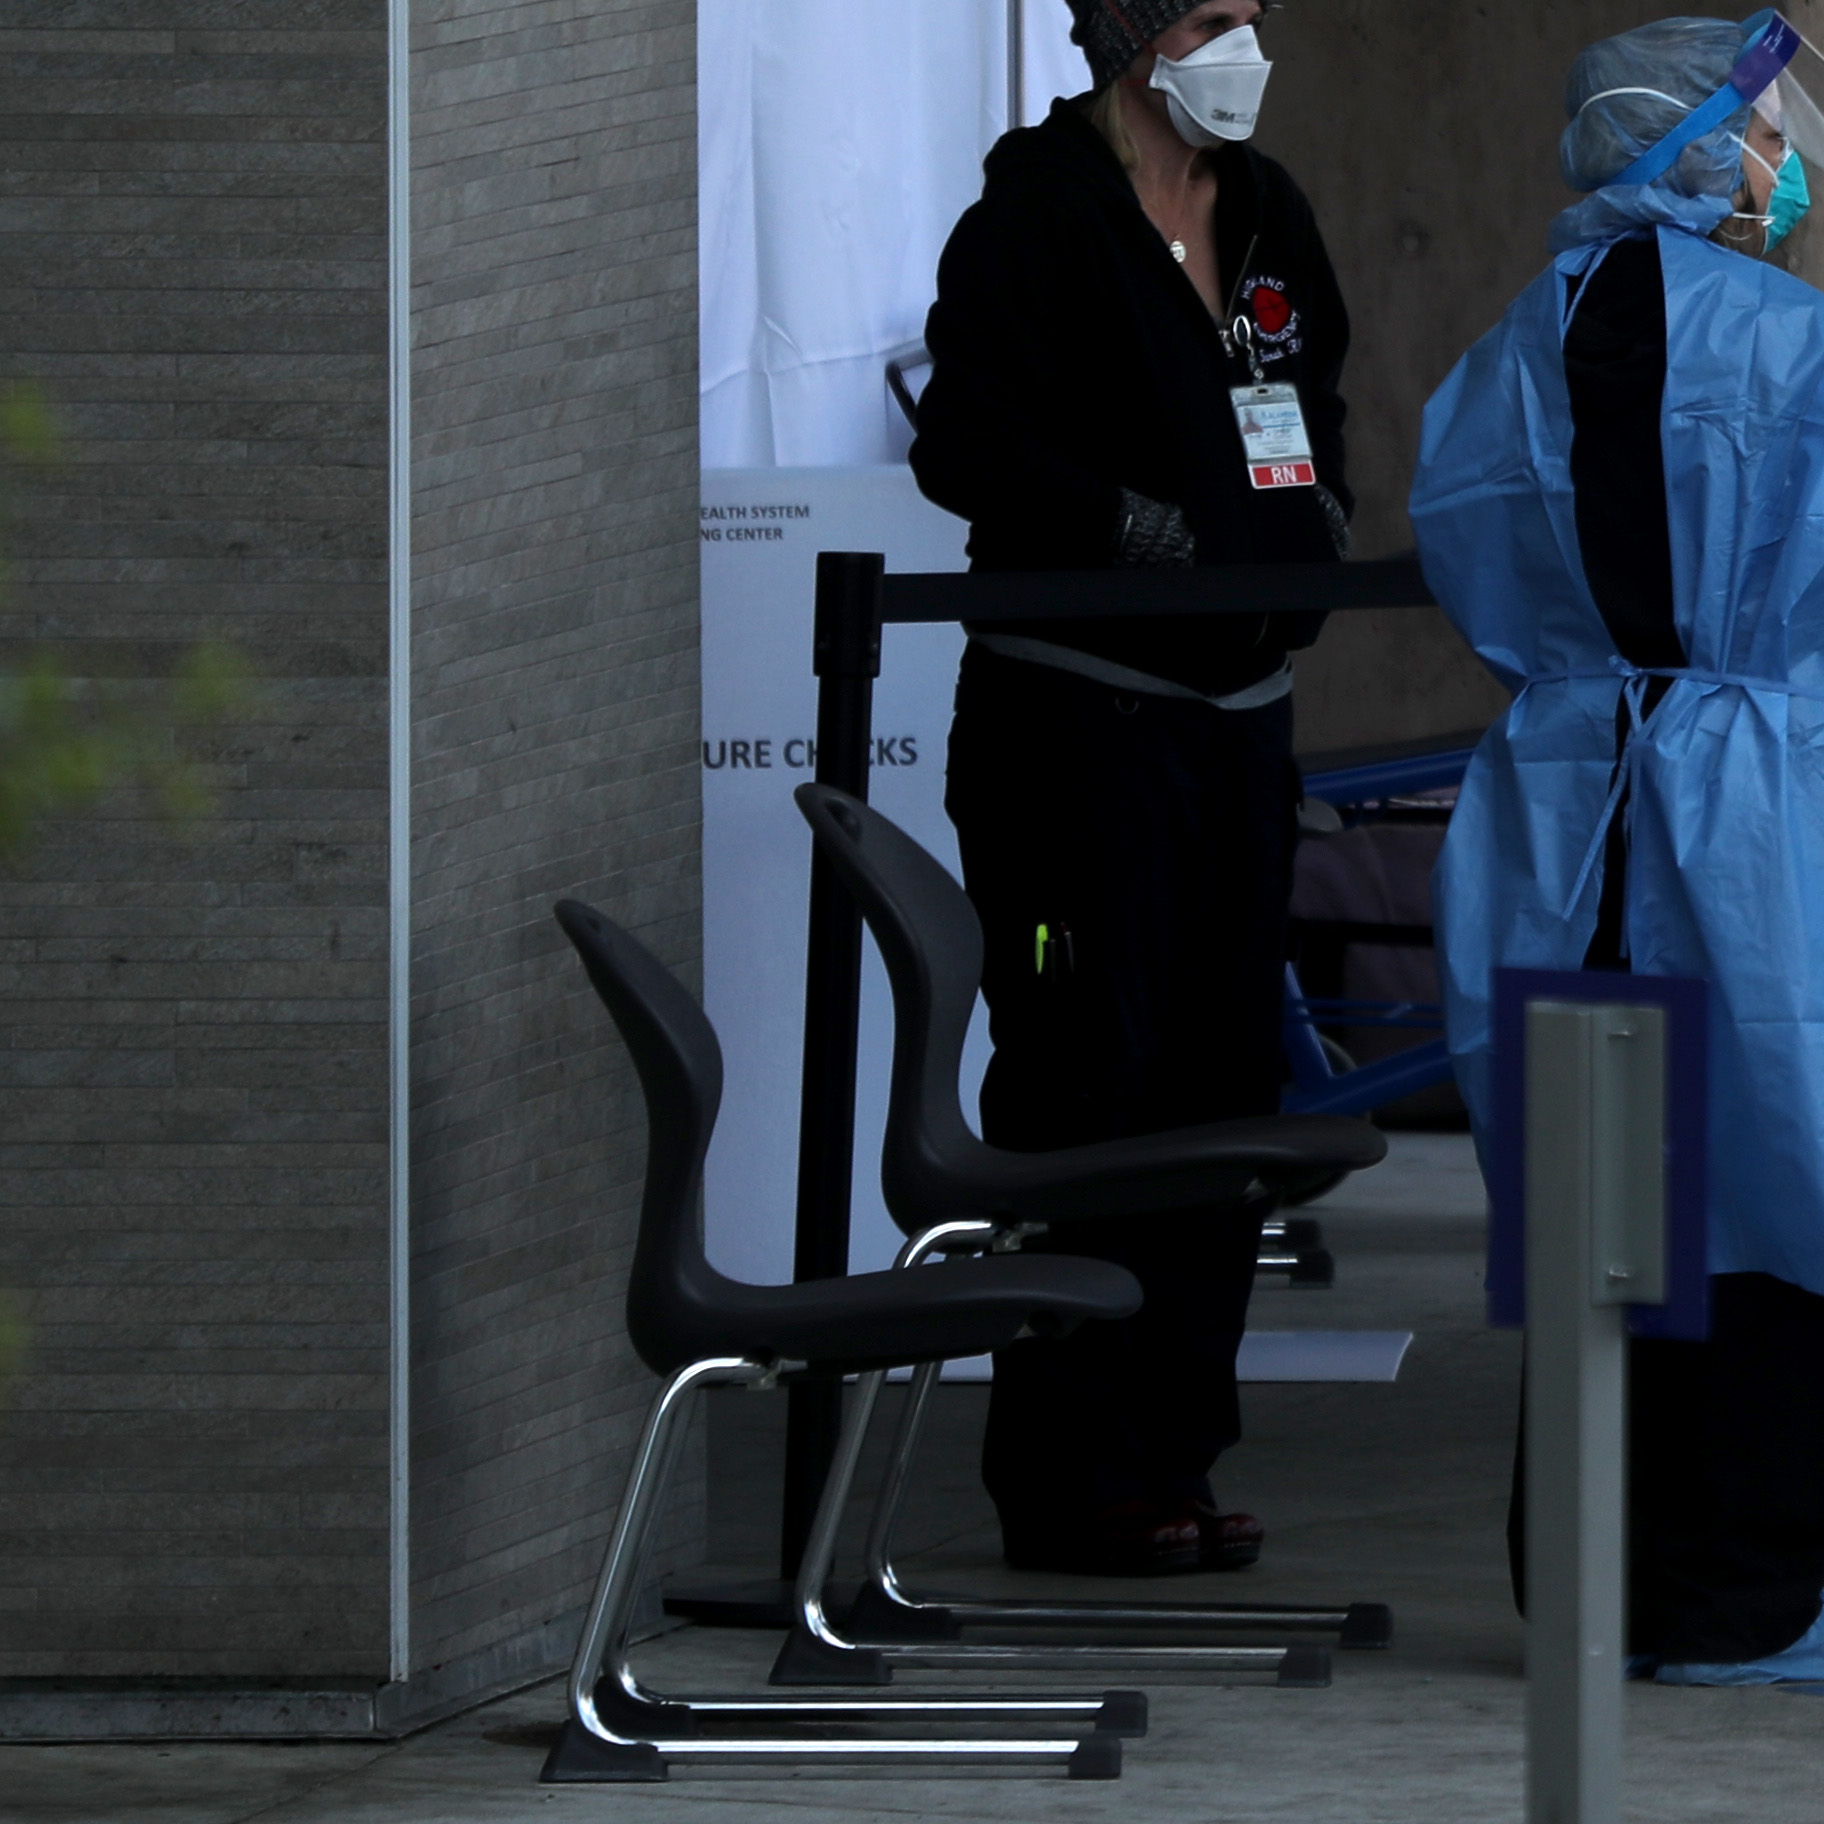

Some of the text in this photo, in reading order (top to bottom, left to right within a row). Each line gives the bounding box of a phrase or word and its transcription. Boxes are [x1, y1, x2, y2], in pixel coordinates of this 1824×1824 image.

[1270, 465, 1297, 485] RN
[700, 505, 810, 520] EALTH SYSTEM
[700, 527, 783, 542] NG CENTER
[702, 740, 773, 770] URE
